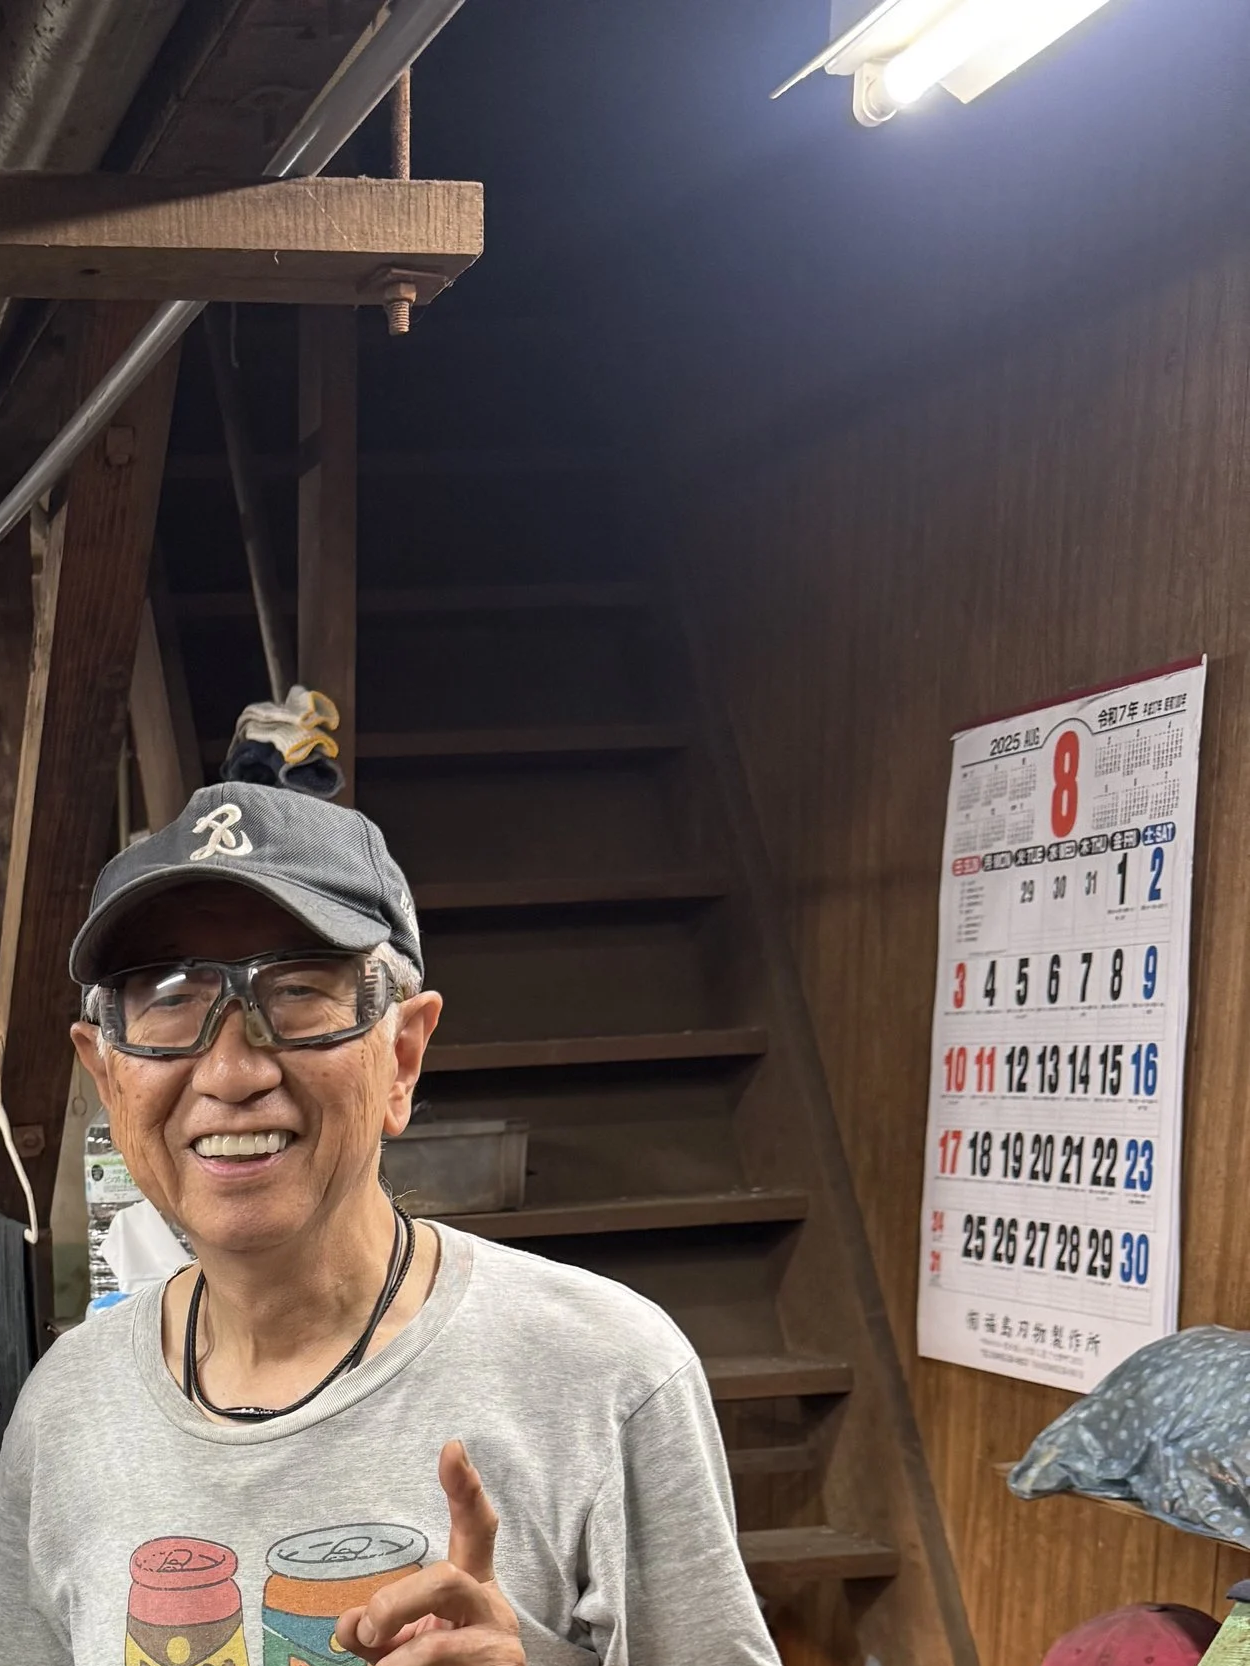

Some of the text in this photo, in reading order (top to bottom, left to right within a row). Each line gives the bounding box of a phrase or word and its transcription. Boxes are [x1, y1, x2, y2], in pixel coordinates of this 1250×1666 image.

[990, 732, 1021, 756] 2025
[1051, 730, 1080, 838] 8
[1116, 852, 1128, 905] 1
[1149, 846, 1165, 901] 2
[953, 945, 1157, 1008] 3 4 5 6 7 8 9
[944, 1042, 1158, 1096] 10 11 12 13 14 15 16
[939, 1130, 1154, 1191] 17 18 19 20 21 22 23
[962, 1214, 986, 1260] 25
[992, 1217, 1018, 1264] 26
[1024, 1220, 1050, 1268] 27
[1055, 1224, 1080, 1273] 28
[1086, 1228, 1114, 1279] 29
[1120, 1232, 1149, 1284] 30
